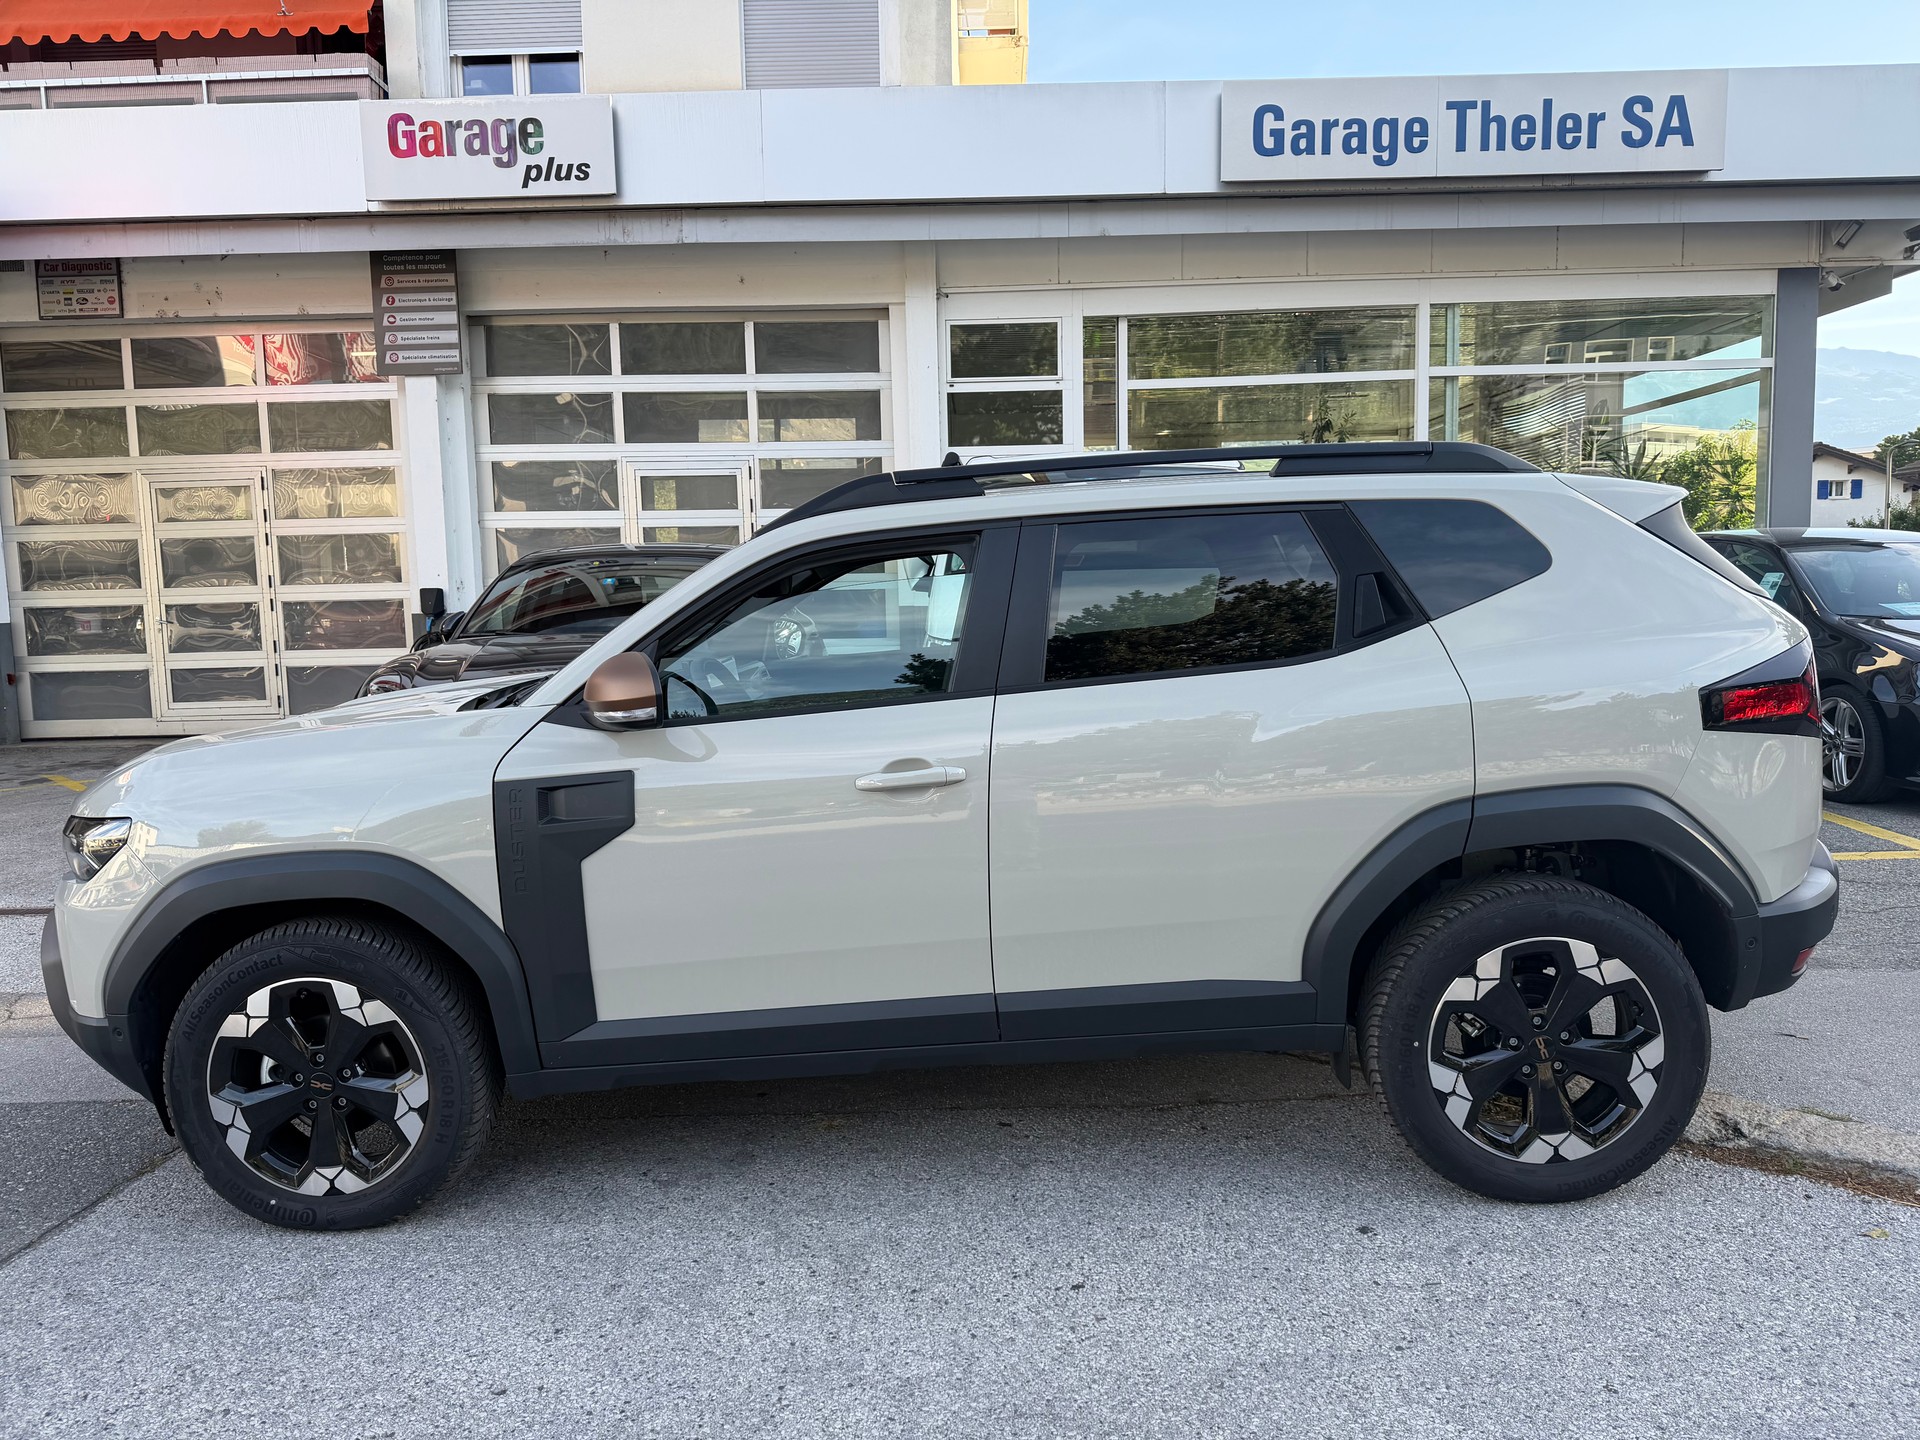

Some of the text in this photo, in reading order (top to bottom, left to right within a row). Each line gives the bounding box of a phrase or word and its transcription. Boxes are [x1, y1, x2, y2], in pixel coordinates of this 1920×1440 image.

[387, 112, 545, 169] Garage
[1252, 94, 1695, 167] Garage Theler SA
[521, 157, 591, 189] plus
[43, 261, 112, 273] Car Diagnostic
[382, 254, 424, 263] Compétence
[509, 788, 529, 894] DUSTER
[182, 953, 284, 1041] AllSeasonContact
[1557, 1115, 1679, 1194] AllSeasonContact
[221, 1179, 318, 1227] Continental
